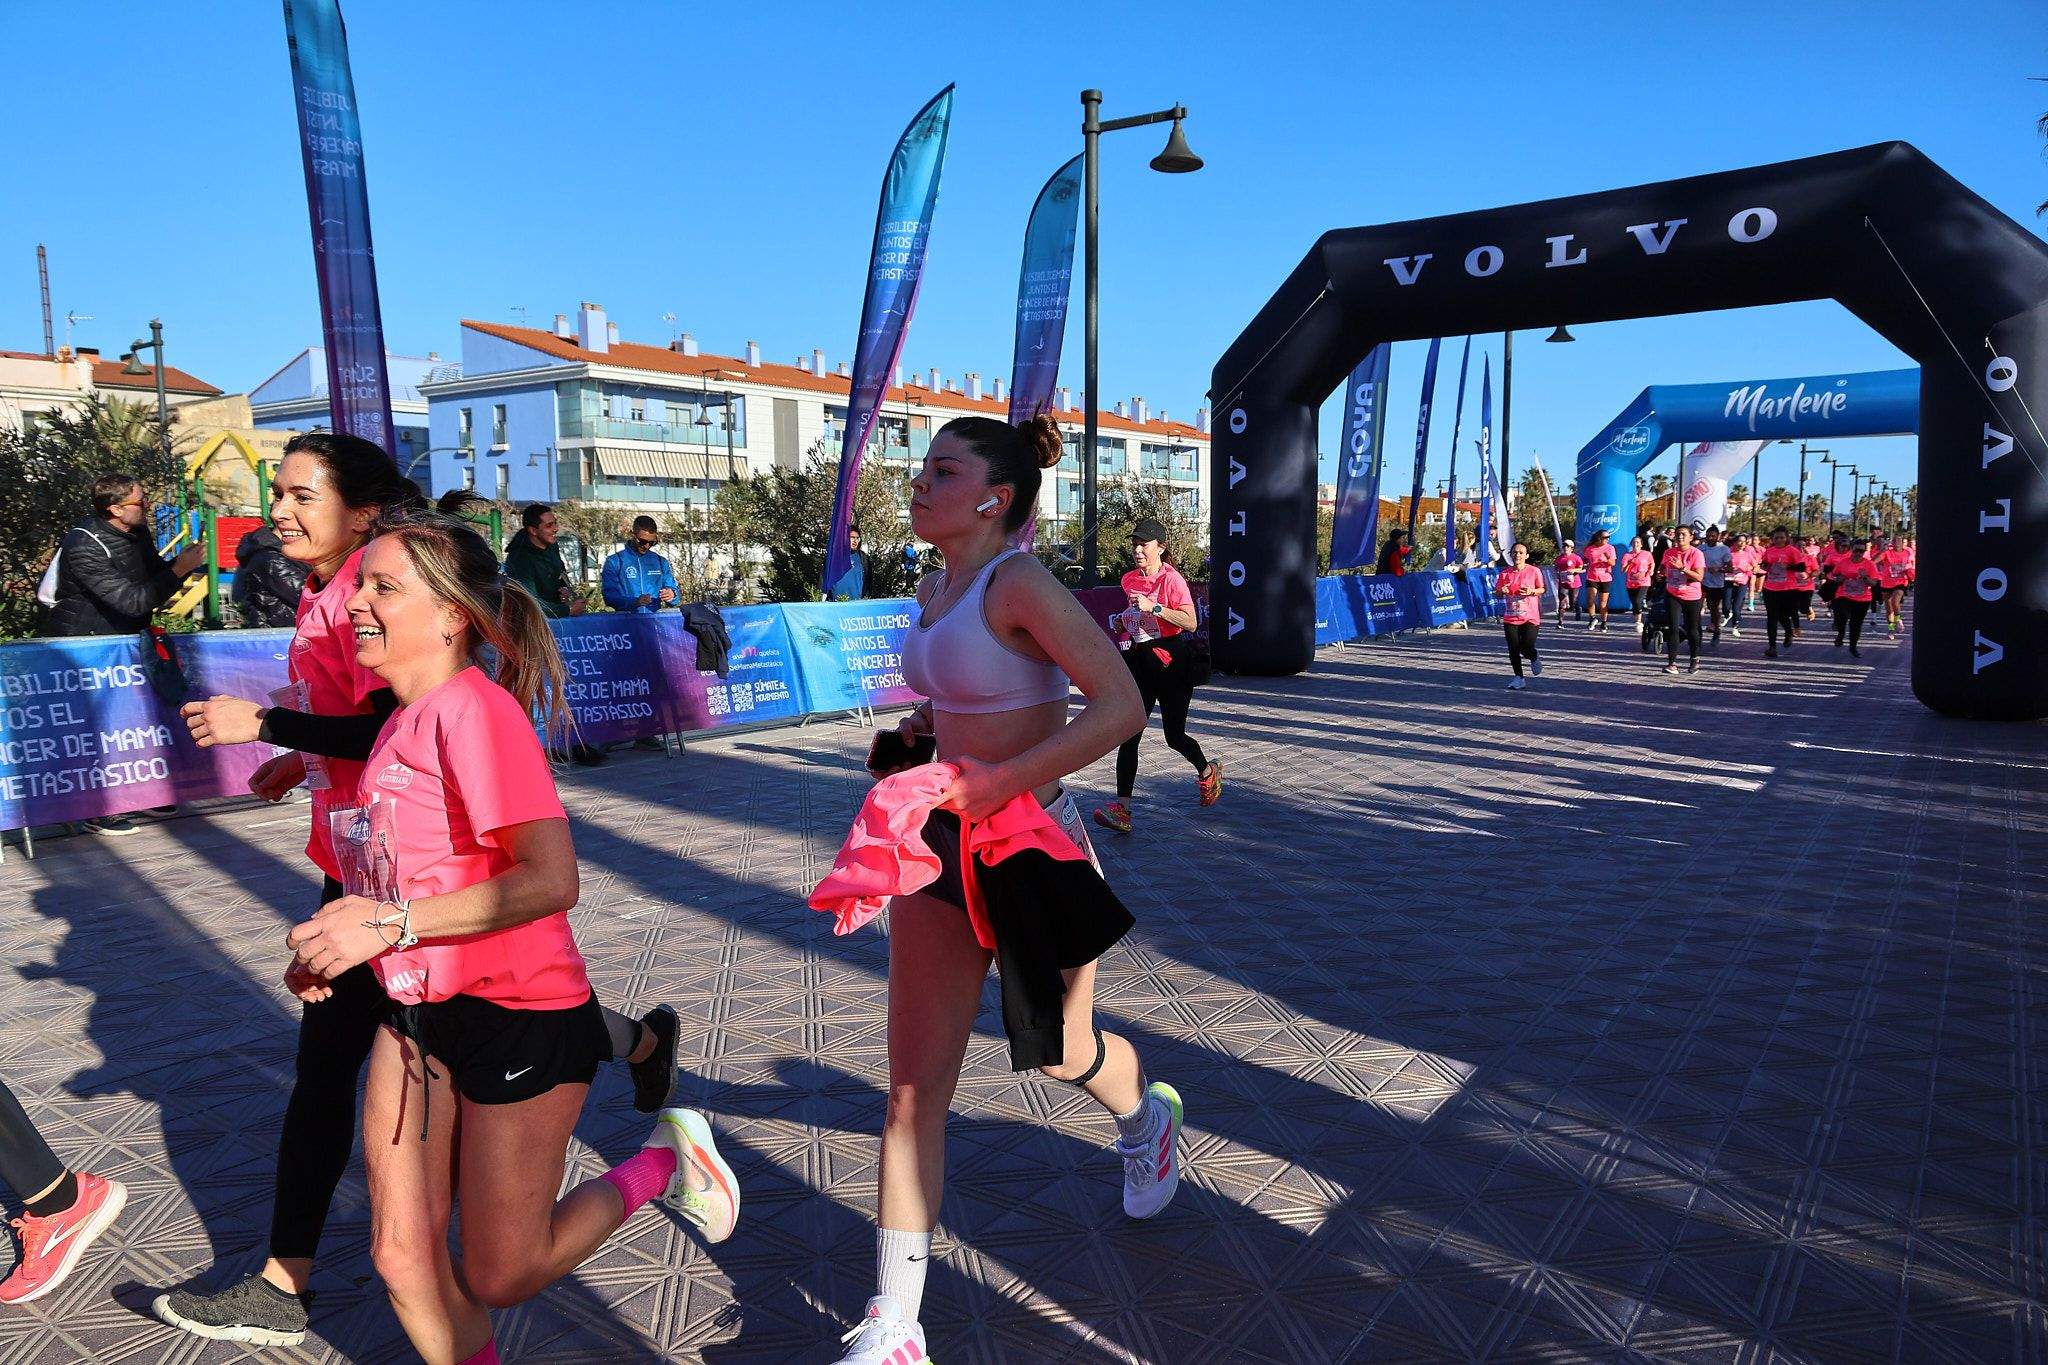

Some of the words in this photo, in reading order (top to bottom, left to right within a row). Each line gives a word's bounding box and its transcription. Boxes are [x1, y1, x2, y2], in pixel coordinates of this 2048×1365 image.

[1383, 206, 1778, 287] VOLVO
[1724, 382, 1847, 433] Marlene
[1347, 382, 1374, 478] GOYA
[1229, 408, 1247, 640] VOLVO
[1972, 356, 2018, 675] VOLVO
[839, 613, 911, 632] VISIBILICEMOS
[840, 634, 877, 652] JUNTOS
[877, 634, 891, 649] EL
[582, 658, 603, 676] EL
[885, 653, 897, 668] DE
[590, 681, 610, 700] DE
[612, 678, 650, 698] MAMA
[48, 702, 85, 726] EL
[62, 732, 97, 757] DE
[100, 724, 173, 754] MAMA
